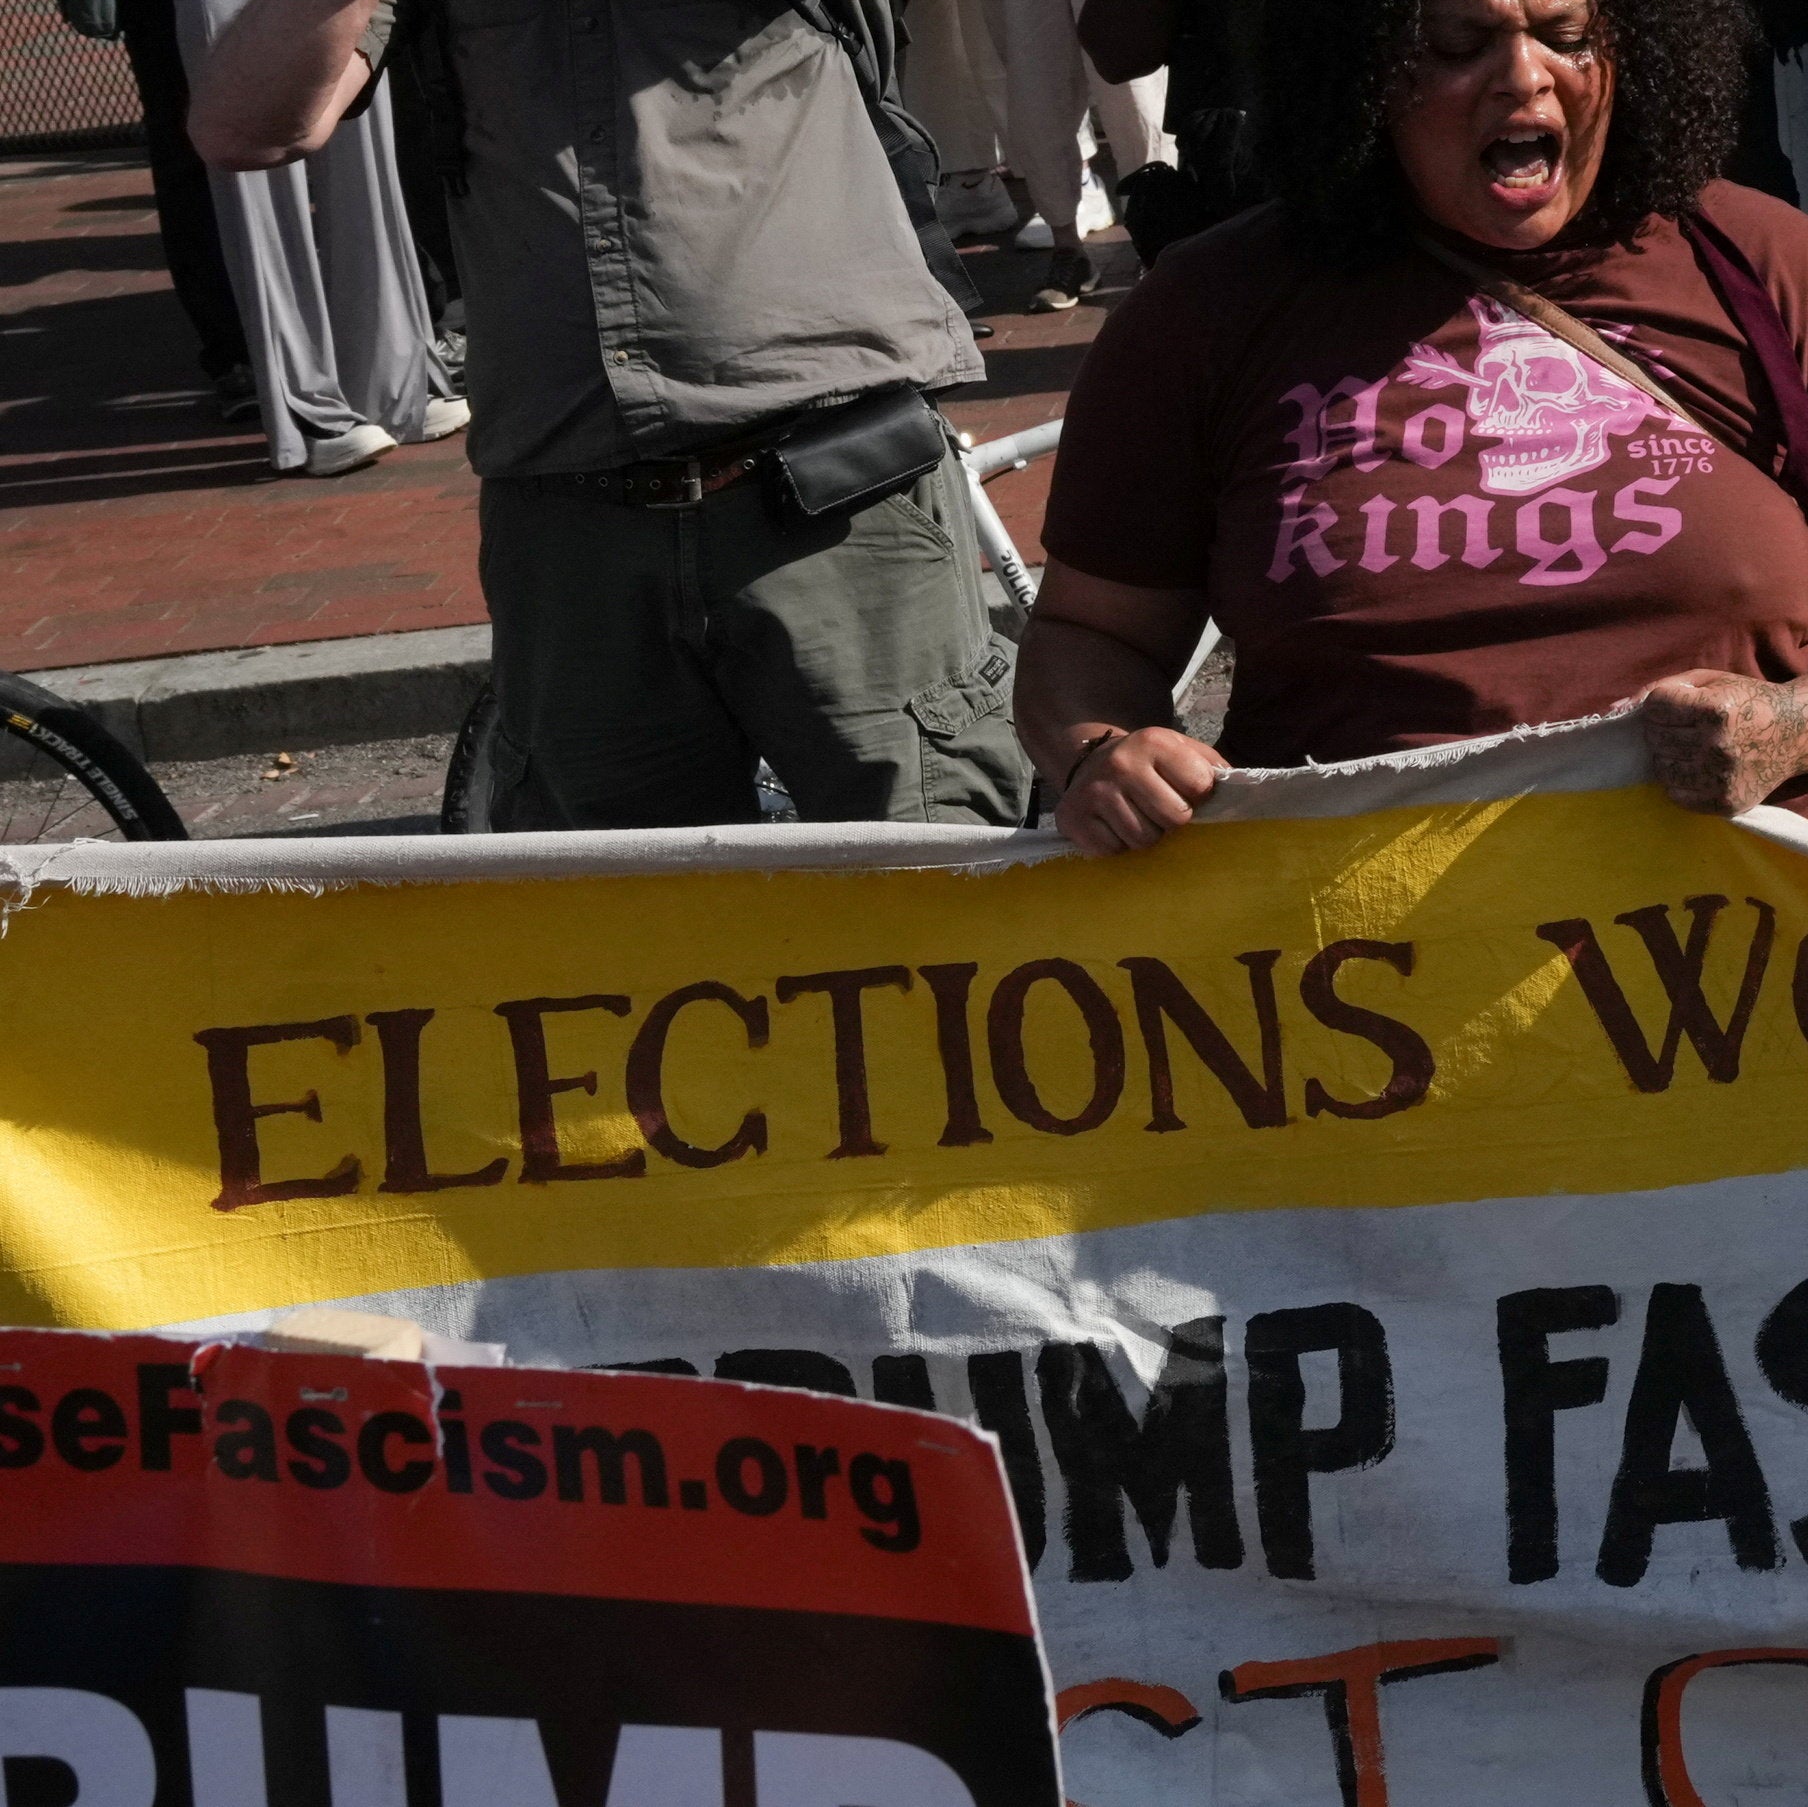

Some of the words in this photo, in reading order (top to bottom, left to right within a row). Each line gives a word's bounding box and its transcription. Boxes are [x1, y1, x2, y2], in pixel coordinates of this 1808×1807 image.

[1278, 376, 1466, 483] No
[1626, 434, 1716, 460] since
[1651, 456, 1714, 476] 1776
[1265, 475, 1683, 587] kings
[193, 937, 1438, 1213] ELECTIONS
